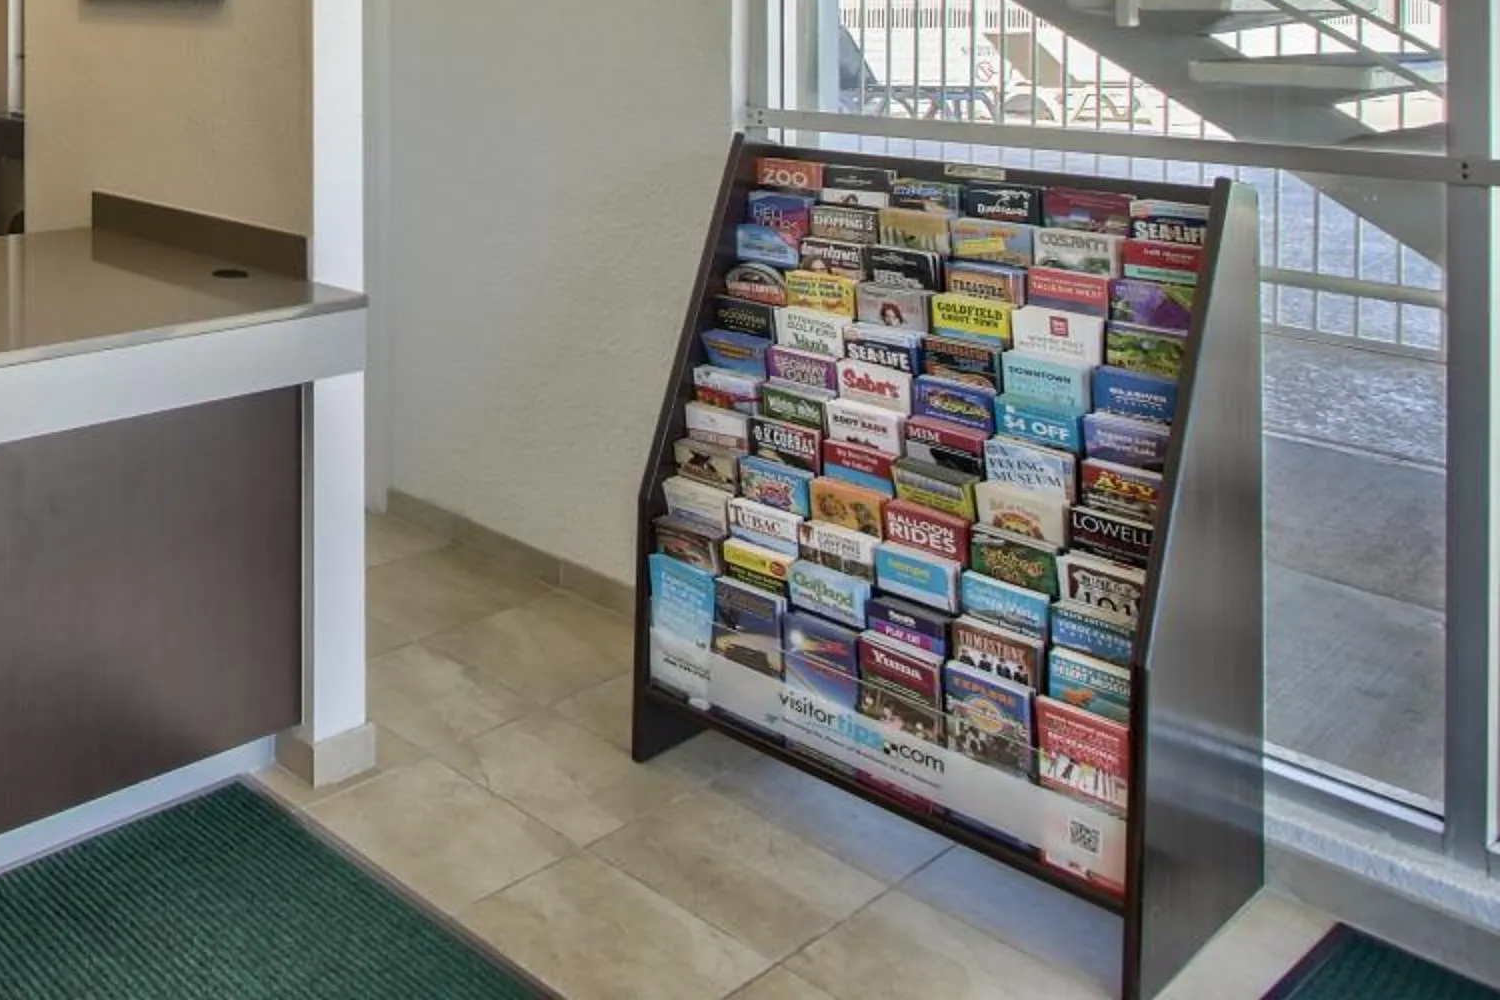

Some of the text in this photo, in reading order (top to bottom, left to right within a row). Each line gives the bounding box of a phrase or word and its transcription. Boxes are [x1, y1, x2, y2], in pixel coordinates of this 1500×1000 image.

[762, 168, 808, 187] ZOO
[936, 302, 1003, 321] GOLDFIELD
[848, 342, 878, 364] SEA
[1007, 365, 1072, 385] DOWNTOWN
[908, 425, 941, 443] MIM
[1003, 414, 1071, 441] $4 OFF
[990, 469, 1062, 489] MUSEUM
[729, 503, 782, 532] TUBAC
[887, 511, 955, 539] BALLOON
[1072, 510, 1151, 547] LOWELL
[889, 523, 957, 553] RIDES
[872, 649, 922, 680] Yuma
